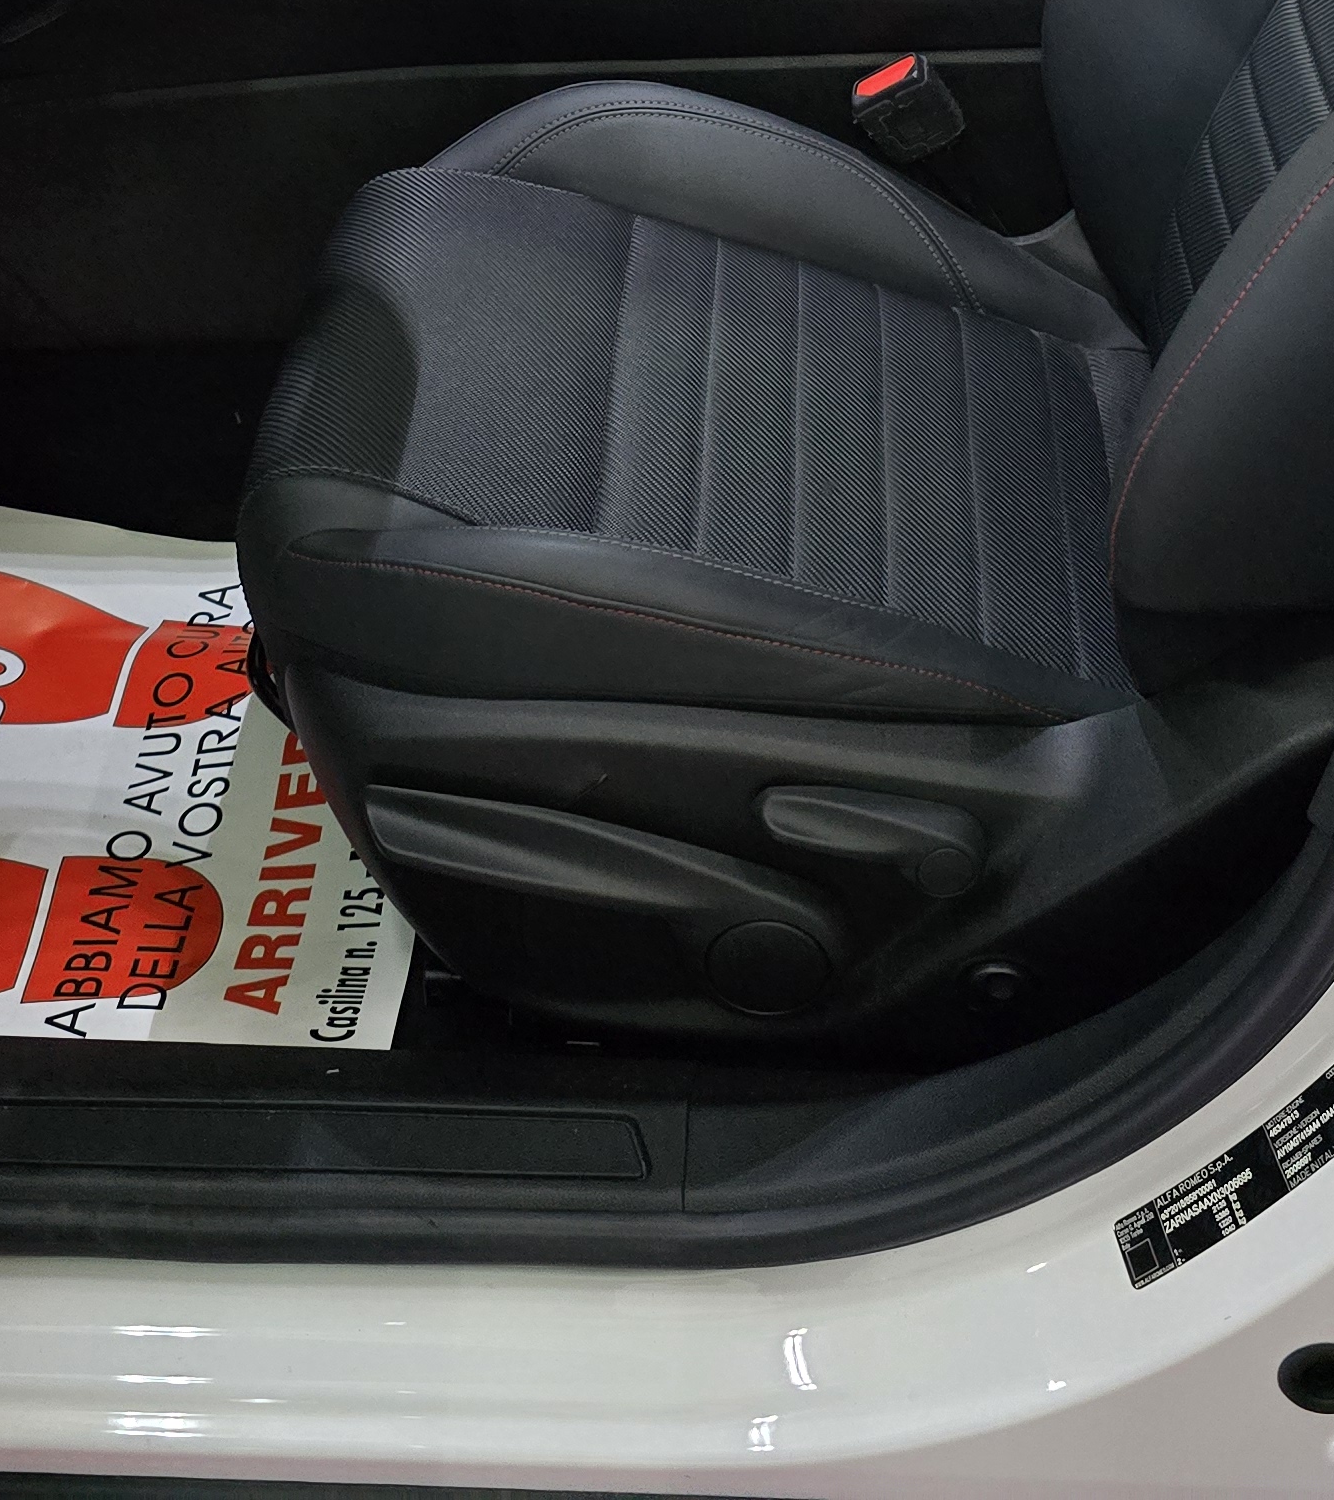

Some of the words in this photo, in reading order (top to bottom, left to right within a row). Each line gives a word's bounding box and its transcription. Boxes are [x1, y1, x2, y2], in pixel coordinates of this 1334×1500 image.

[44, 829, 153, 1039] ABBIAMO
[122, 671, 195, 817] AVUTO
[166, 583, 242, 659] CURA
[115, 883, 204, 1011] DELLA
[165, 690, 248, 870] VOSTRA
[336, 887, 386, 932] 125
[344, 940, 378, 960] n.
[309, 966, 372, 1043] Casilina
[1156, 1187, 1181, 1209] ALFA
[1177, 1168, 1209, 1194] ROMEO
[1207, 1153, 1234, 1175] S.p.A.
[1288, 1166, 1312, 1189] MADE
